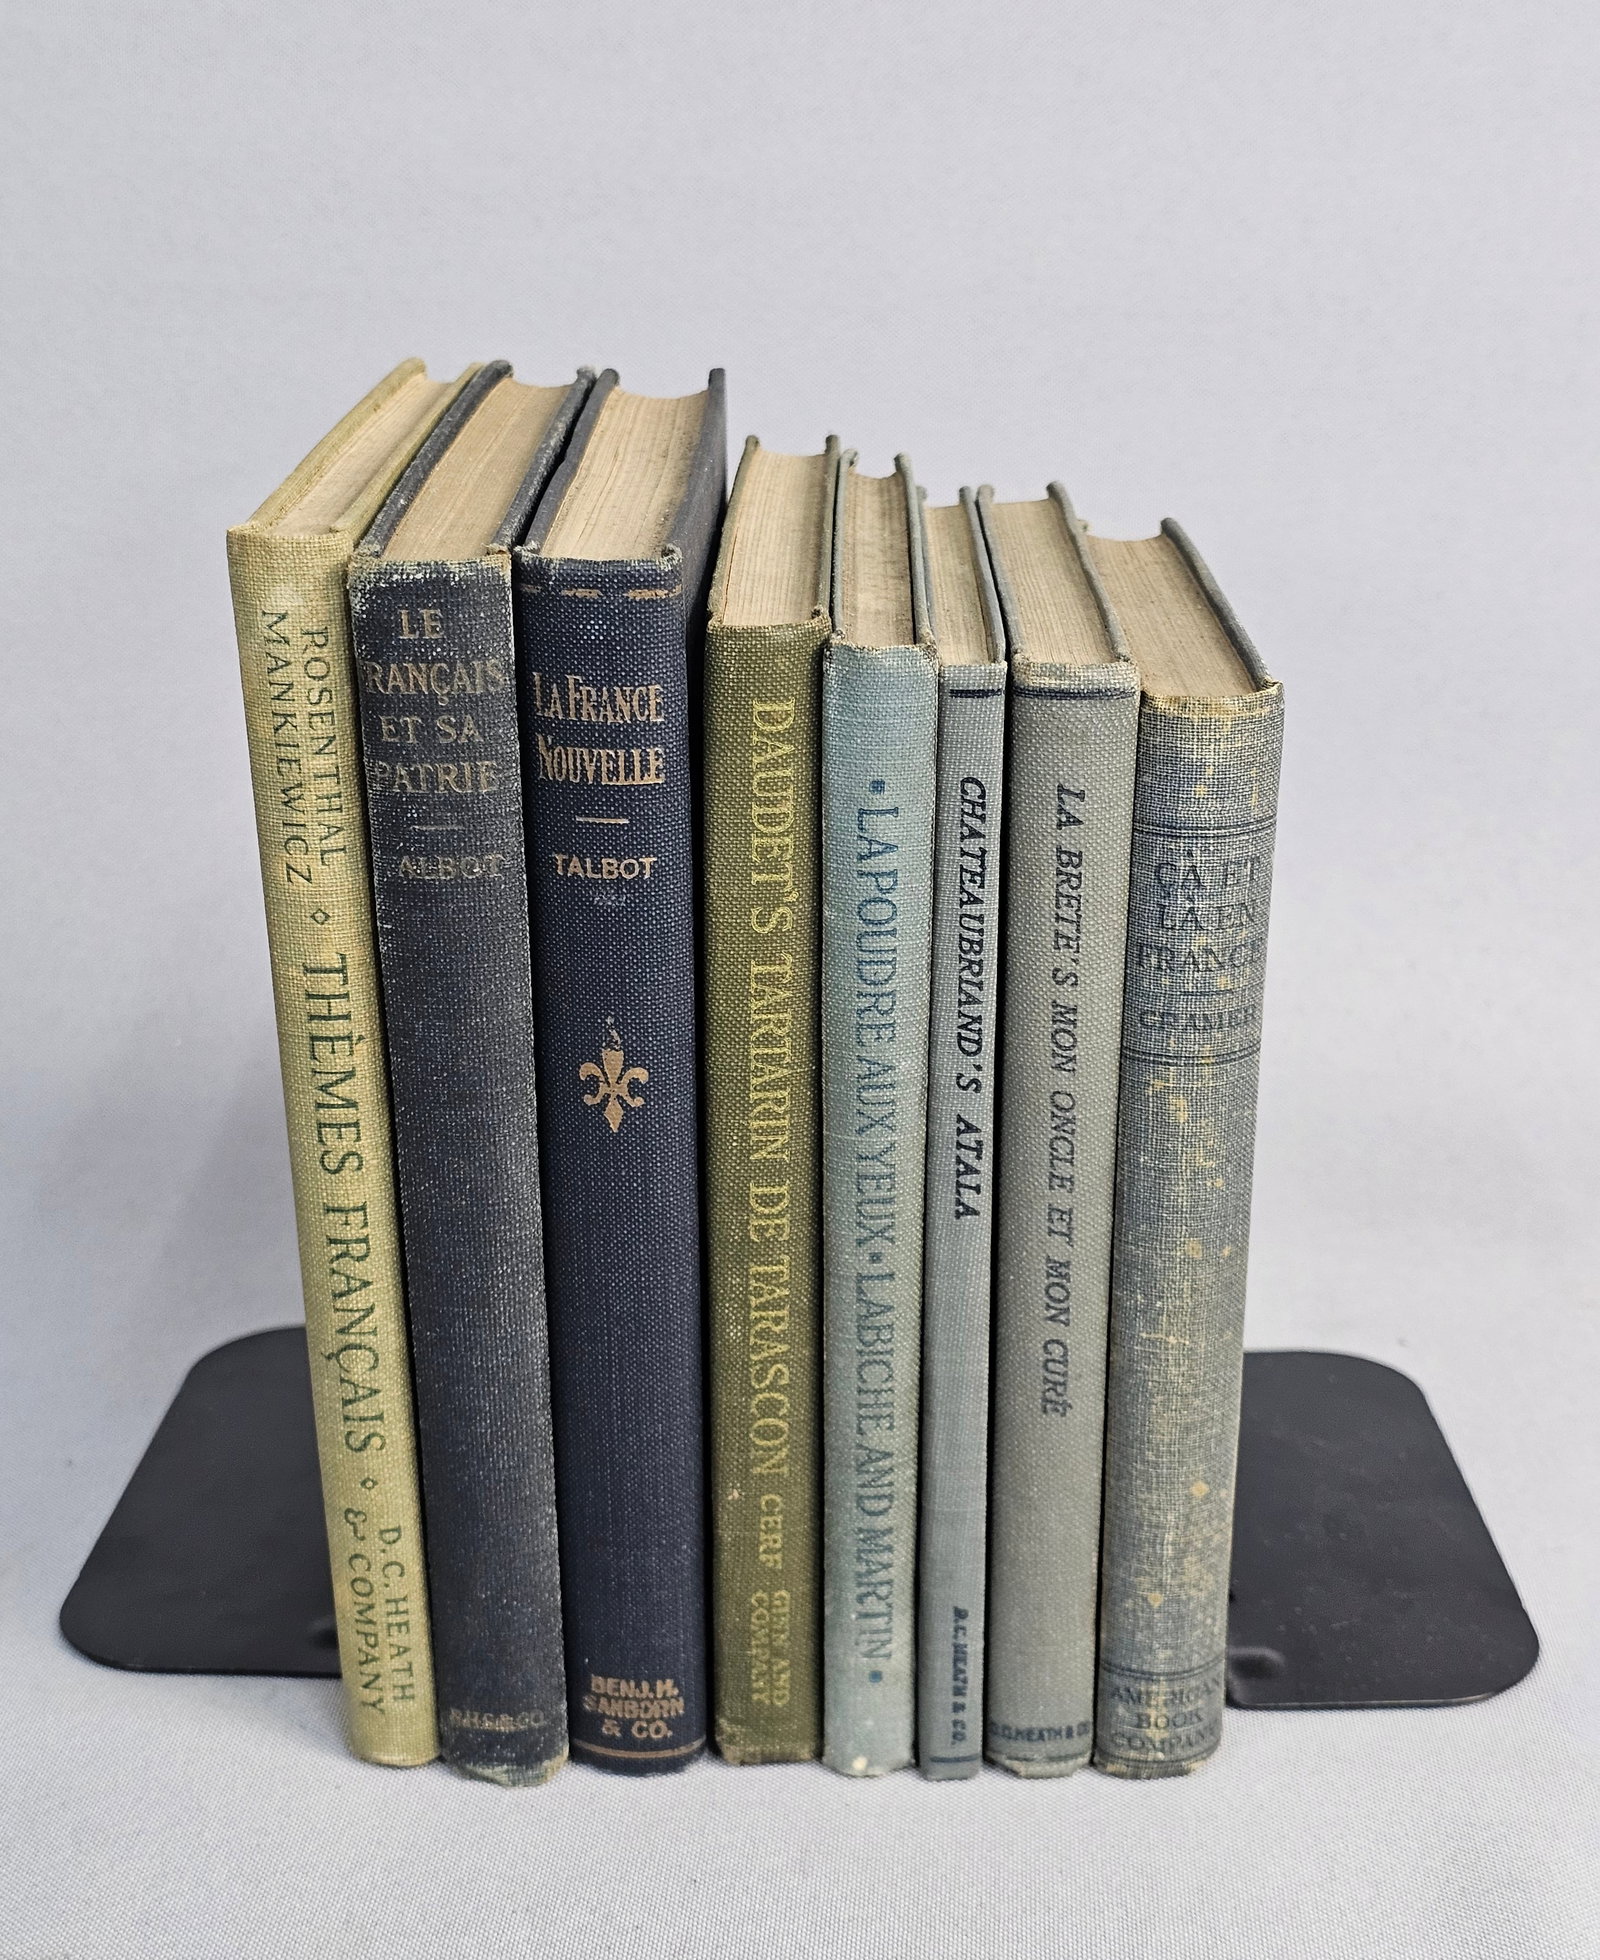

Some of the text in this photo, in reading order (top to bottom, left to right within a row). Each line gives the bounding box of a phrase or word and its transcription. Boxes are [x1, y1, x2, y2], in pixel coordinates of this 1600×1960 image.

[400, 609, 445, 640] LE
[361, 659, 510, 706] RANÇAIS
[262, 610, 313, 885] MANKIEWICZ
[301, 626, 347, 867] ROSENTHAL
[380, 714, 484, 745] ET SA
[373, 758, 501, 794] PATRIE
[535, 733, 667, 786] NOUVELLE
[399, 853, 507, 880] ALBOT
[555, 852, 659, 880] TALBOT
[1221, 856, 1261, 888] ET
[1216, 898, 1257, 931] EN
[1135, 937, 1265, 973] FRANCE
[955, 776, 988, 1221] CHATEAUBRIAND'S ATALA
[856, 1055, 897, 1135] AUX
[1041, 783, 1086, 1418] LA BRETE'S MON ONCLE ET MON CURÉ
[749, 697, 799, 1569] DAUDET'S TARTARIN DE TARASCON CERF
[302, 952, 387, 1454] THÈMES FRANÇAIS
[856, 1142, 897, 1248] YEUX
[856, 1272, 896, 1436] LABICHE
[856, 1442, 895, 1518] AND
[344, 1506, 385, 1716] & COMPANY
[855, 1525, 895, 1660] MARTIN
[385, 1594, 416, 1702] HEATH
[750, 1589, 770, 1705] COMPANY
[583, 1693, 686, 1720] SANBORN
[772, 1658, 791, 1707] AND
[1111, 1676, 1222, 1706] AMERICAN
[601, 1718, 674, 1740] & CO.
[952, 1701, 967, 1714] &
[1135, 1706, 1203, 1731] BOOK
[1110, 1719, 1218, 1753] COMPANY
